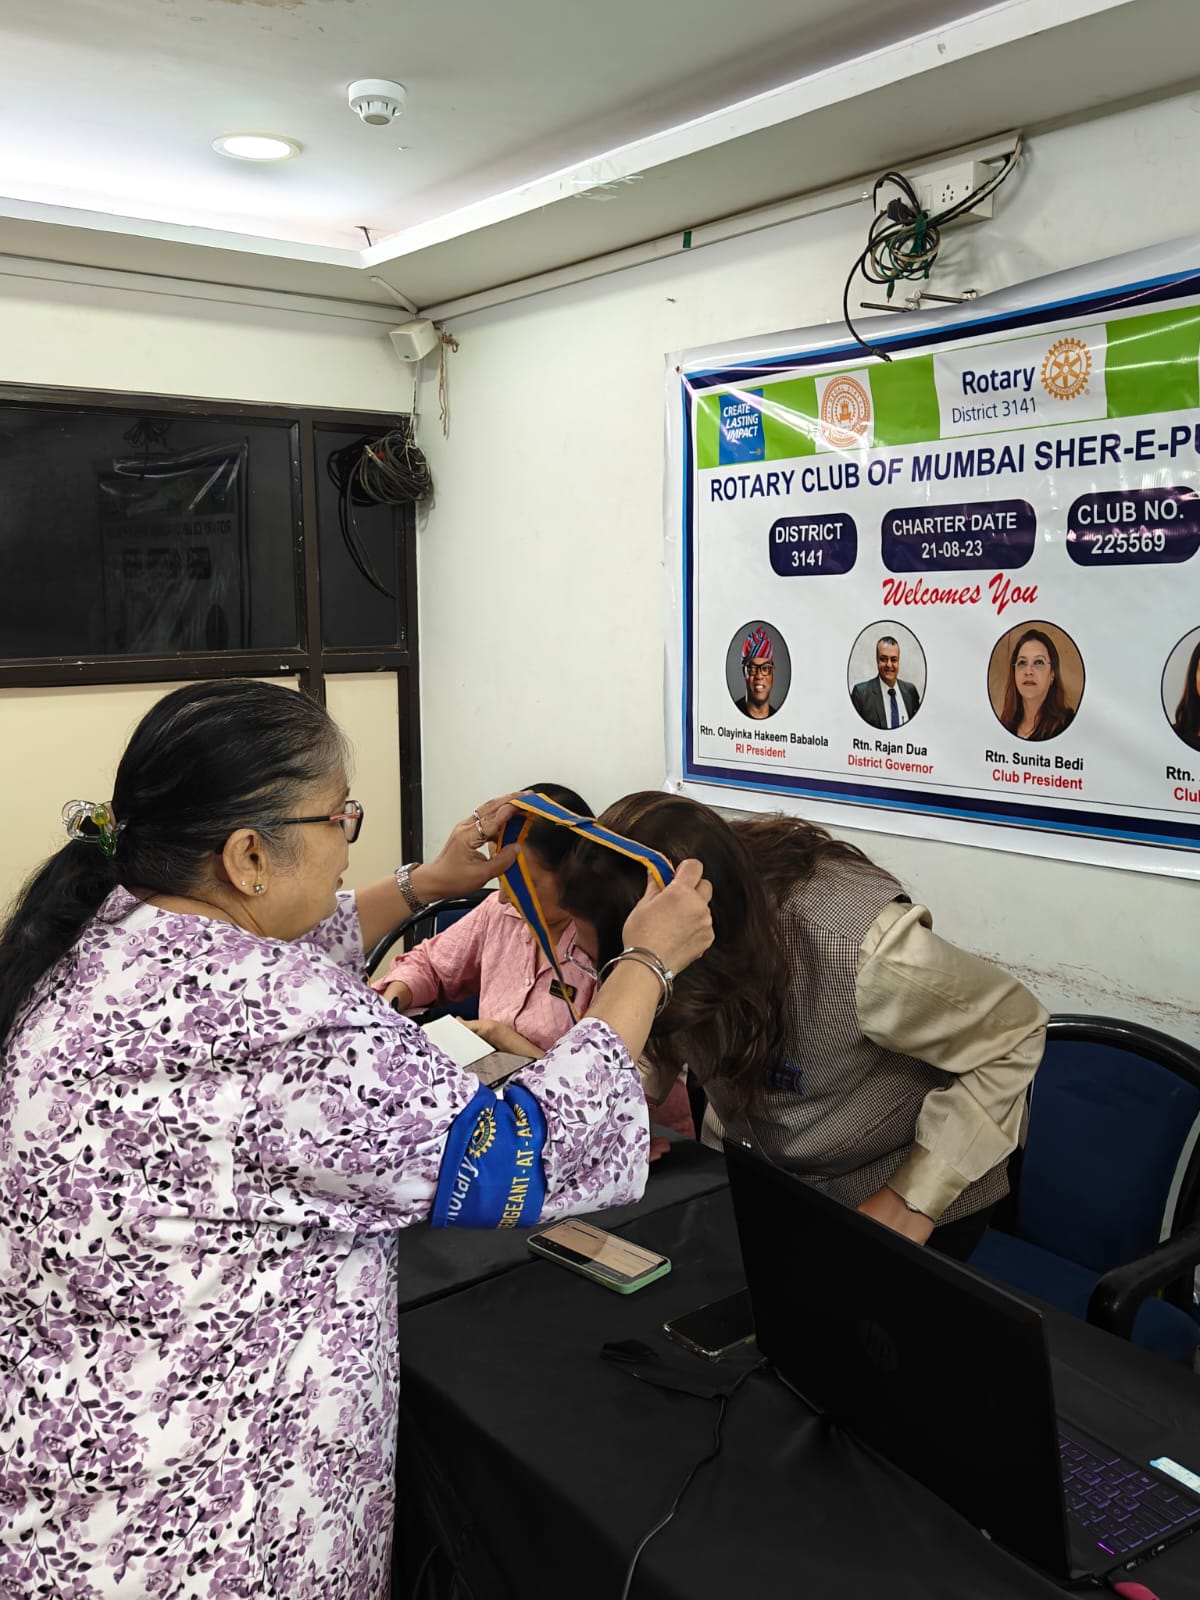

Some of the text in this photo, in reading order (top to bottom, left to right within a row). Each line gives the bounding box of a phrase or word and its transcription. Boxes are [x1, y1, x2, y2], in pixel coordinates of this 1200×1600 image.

[963, 366, 1036, 395] Rotary
[723, 403, 751, 417] CREATE
[952, 397, 1036, 423] District 3141
[726, 414, 759, 429] LASTING
[727, 426, 758, 440] IMPACT
[710, 423, 1200, 502] ROTARY CLUB OF MUMBAI SHER-E-P
[1077, 498, 1184, 525] CLUB NO.
[775, 522, 843, 543] DISTRICT
[892, 512, 1017, 537] CHARTER DATE
[921, 541, 983, 559] 21-08-23
[1091, 534, 1166, 555] 225569
[791, 550, 823, 567] 3141
[882, 572, 1038, 616] Welcomes You
[700, 725, 829, 747] Rtn. Olayinka Hakeem Babalola
[736, 743, 786, 758] RI President
[853, 738, 928, 756] Rtn. Rajan Dua
[848, 754, 934, 774] District Governor
[985, 749, 1084, 771] Rtn. Sunita Bedi
[992, 768, 1083, 790] Club President
[1166, 765, 1195, 782] Rtn.
[1174, 787, 1200, 803] Clu
